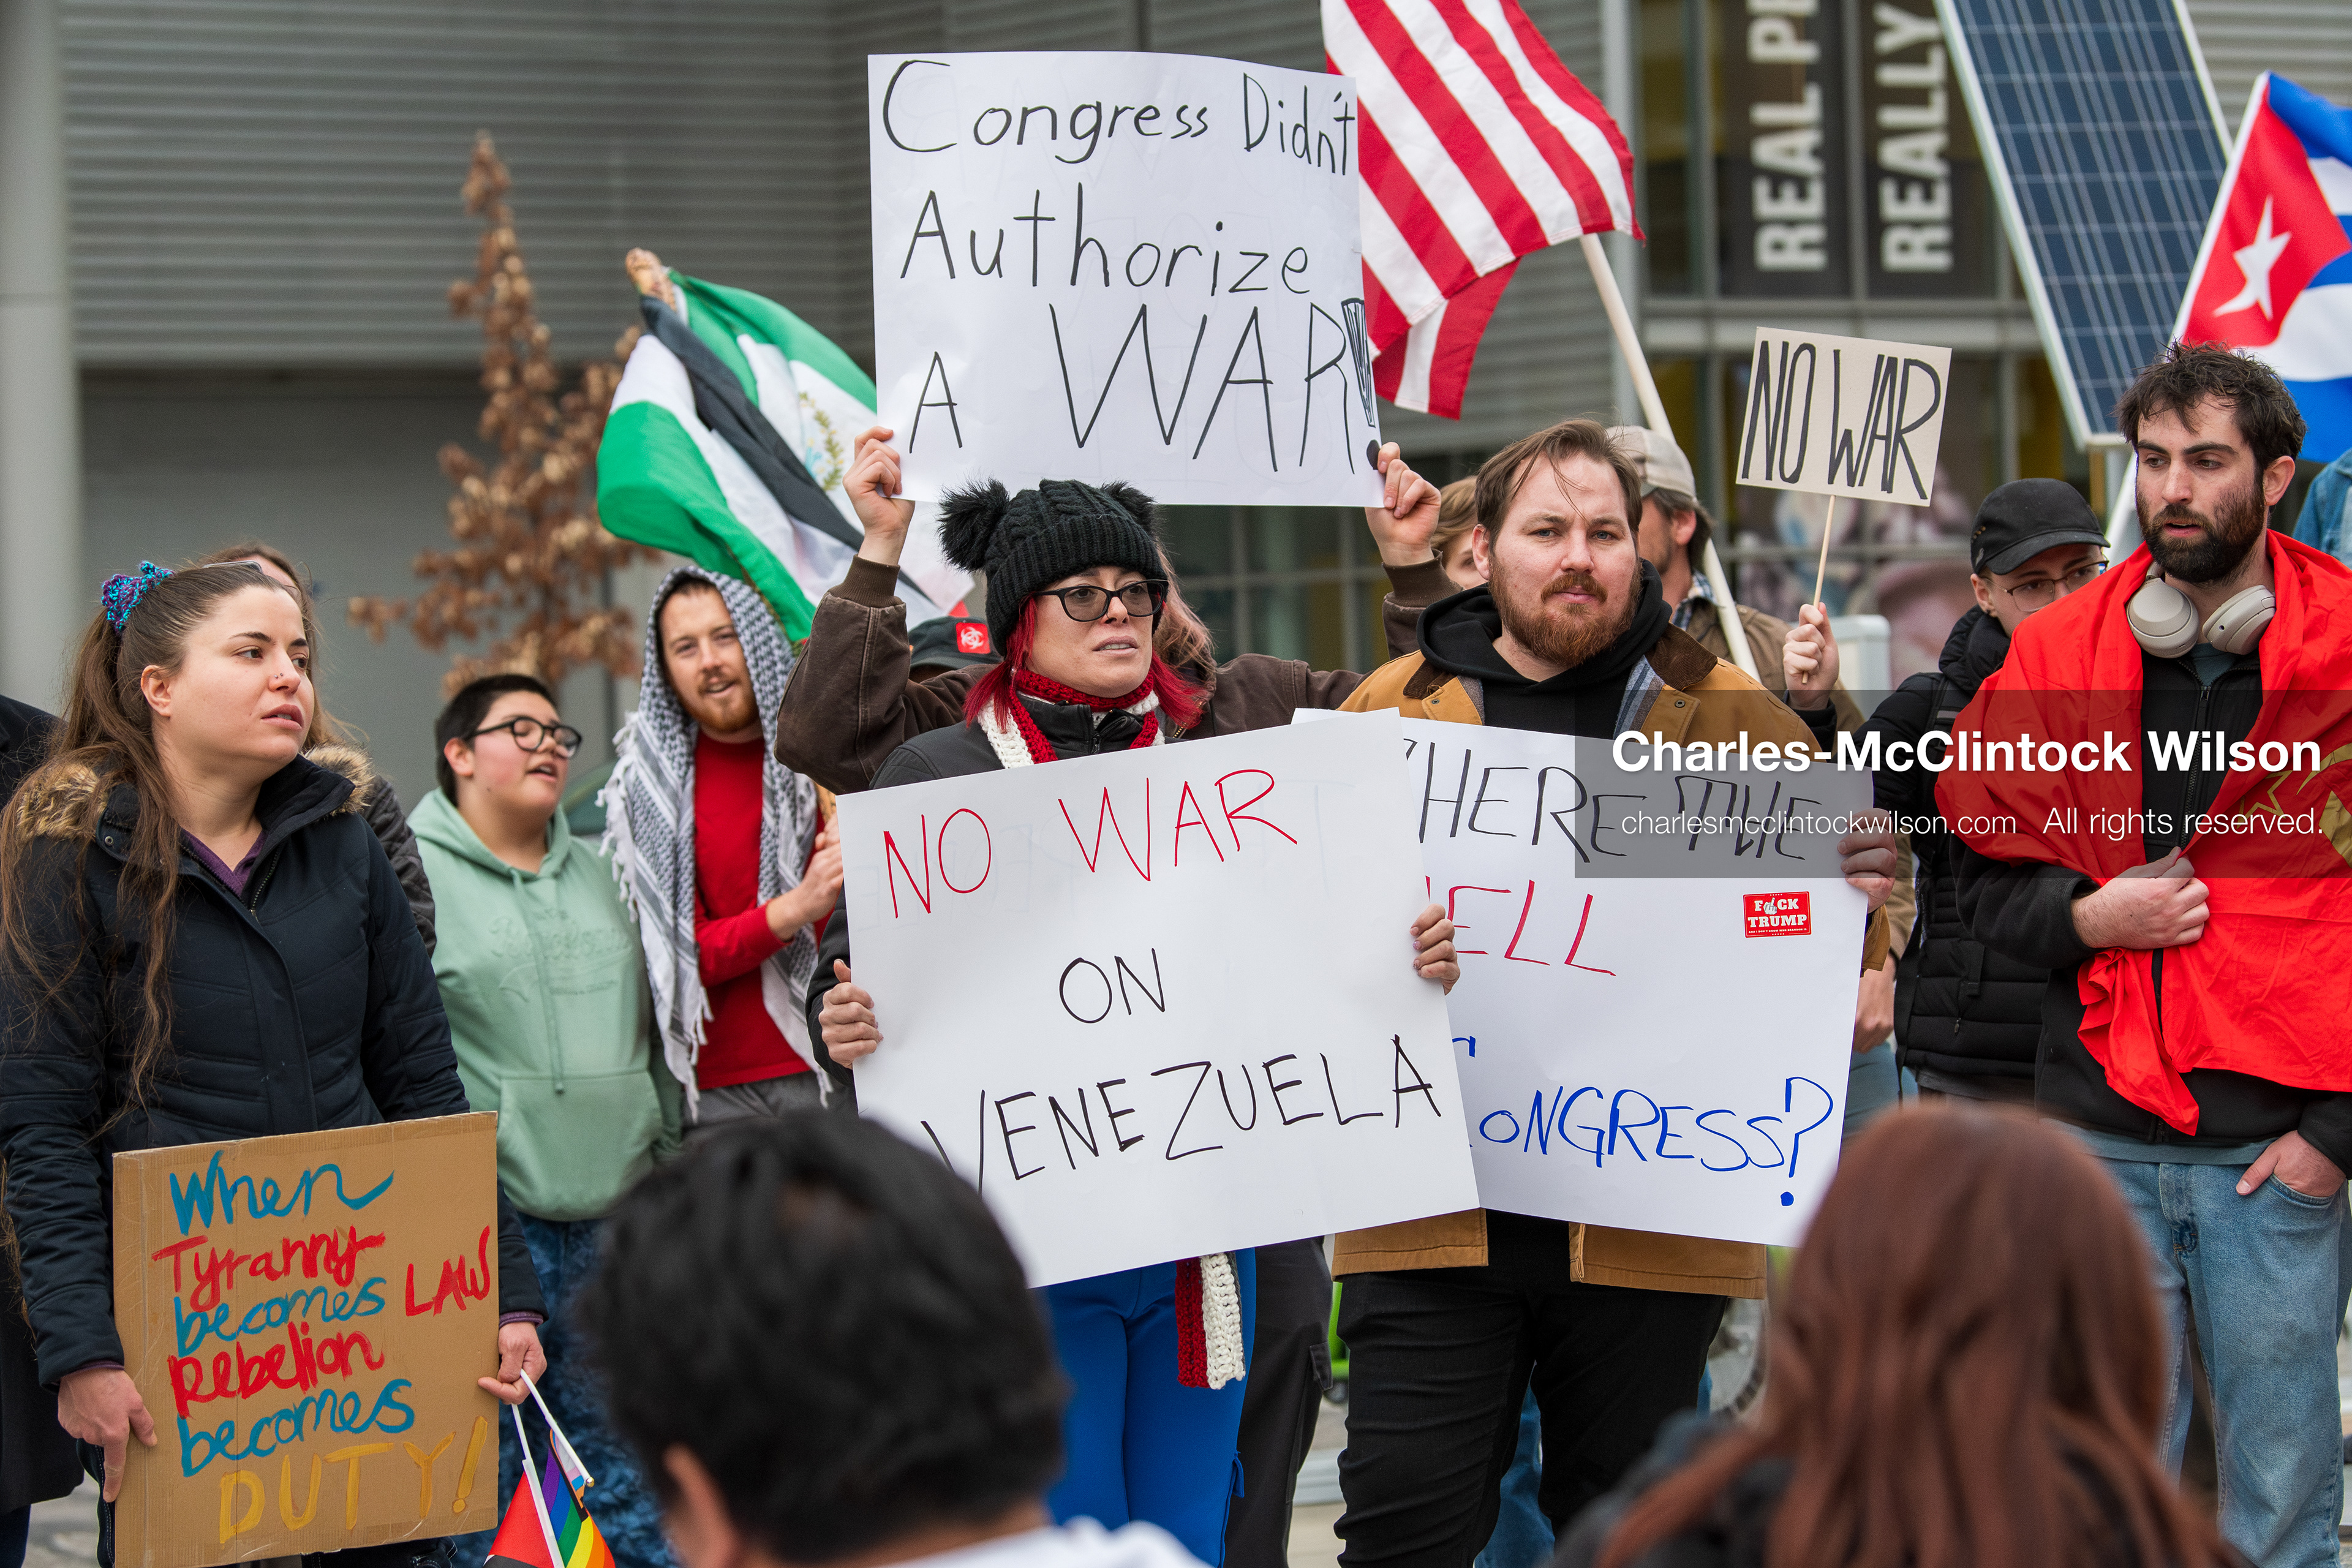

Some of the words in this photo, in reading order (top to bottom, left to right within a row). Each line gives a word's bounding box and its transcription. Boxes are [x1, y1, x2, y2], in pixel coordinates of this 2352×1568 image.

[883, 59, 1208, 164] Congress
[1243, 72, 1356, 176] Didn't
[1749, 83, 1828, 271] REAL
[1873, 2, 1954, 272] REALLY
[900, 182, 1310, 296] Authorize
[908, 352, 963, 454] A
[1049, 298, 1379, 475] WAR!
[1742, 340, 1816, 484] NO
[1827, 349, 1941, 500] WAR
[883, 807, 992, 918] NO
[1058, 769, 1298, 881] WAR
[1403, 737, 1647, 863] HERE
[1674, 775, 1822, 861] THE
[1425, 876, 1616, 976] ELL
[1747, 914, 1807, 928] TRUMP
[1754, 897, 1799, 914] FCK
[1059, 948, 1165, 1023] ON
[921, 1035, 1442, 1194] VENEZUELA
[1469, 1076, 1834, 1207] ONGRESS?
[170, 1149, 395, 1236] When
[151, 1226, 386, 1313] Tyranny
[174, 1276, 387, 1359] becomes
[405, 1225, 491, 1317] LAW
[177, 1378, 415, 1477] becomes
[219, 1416, 488, 1544] DUTY!
